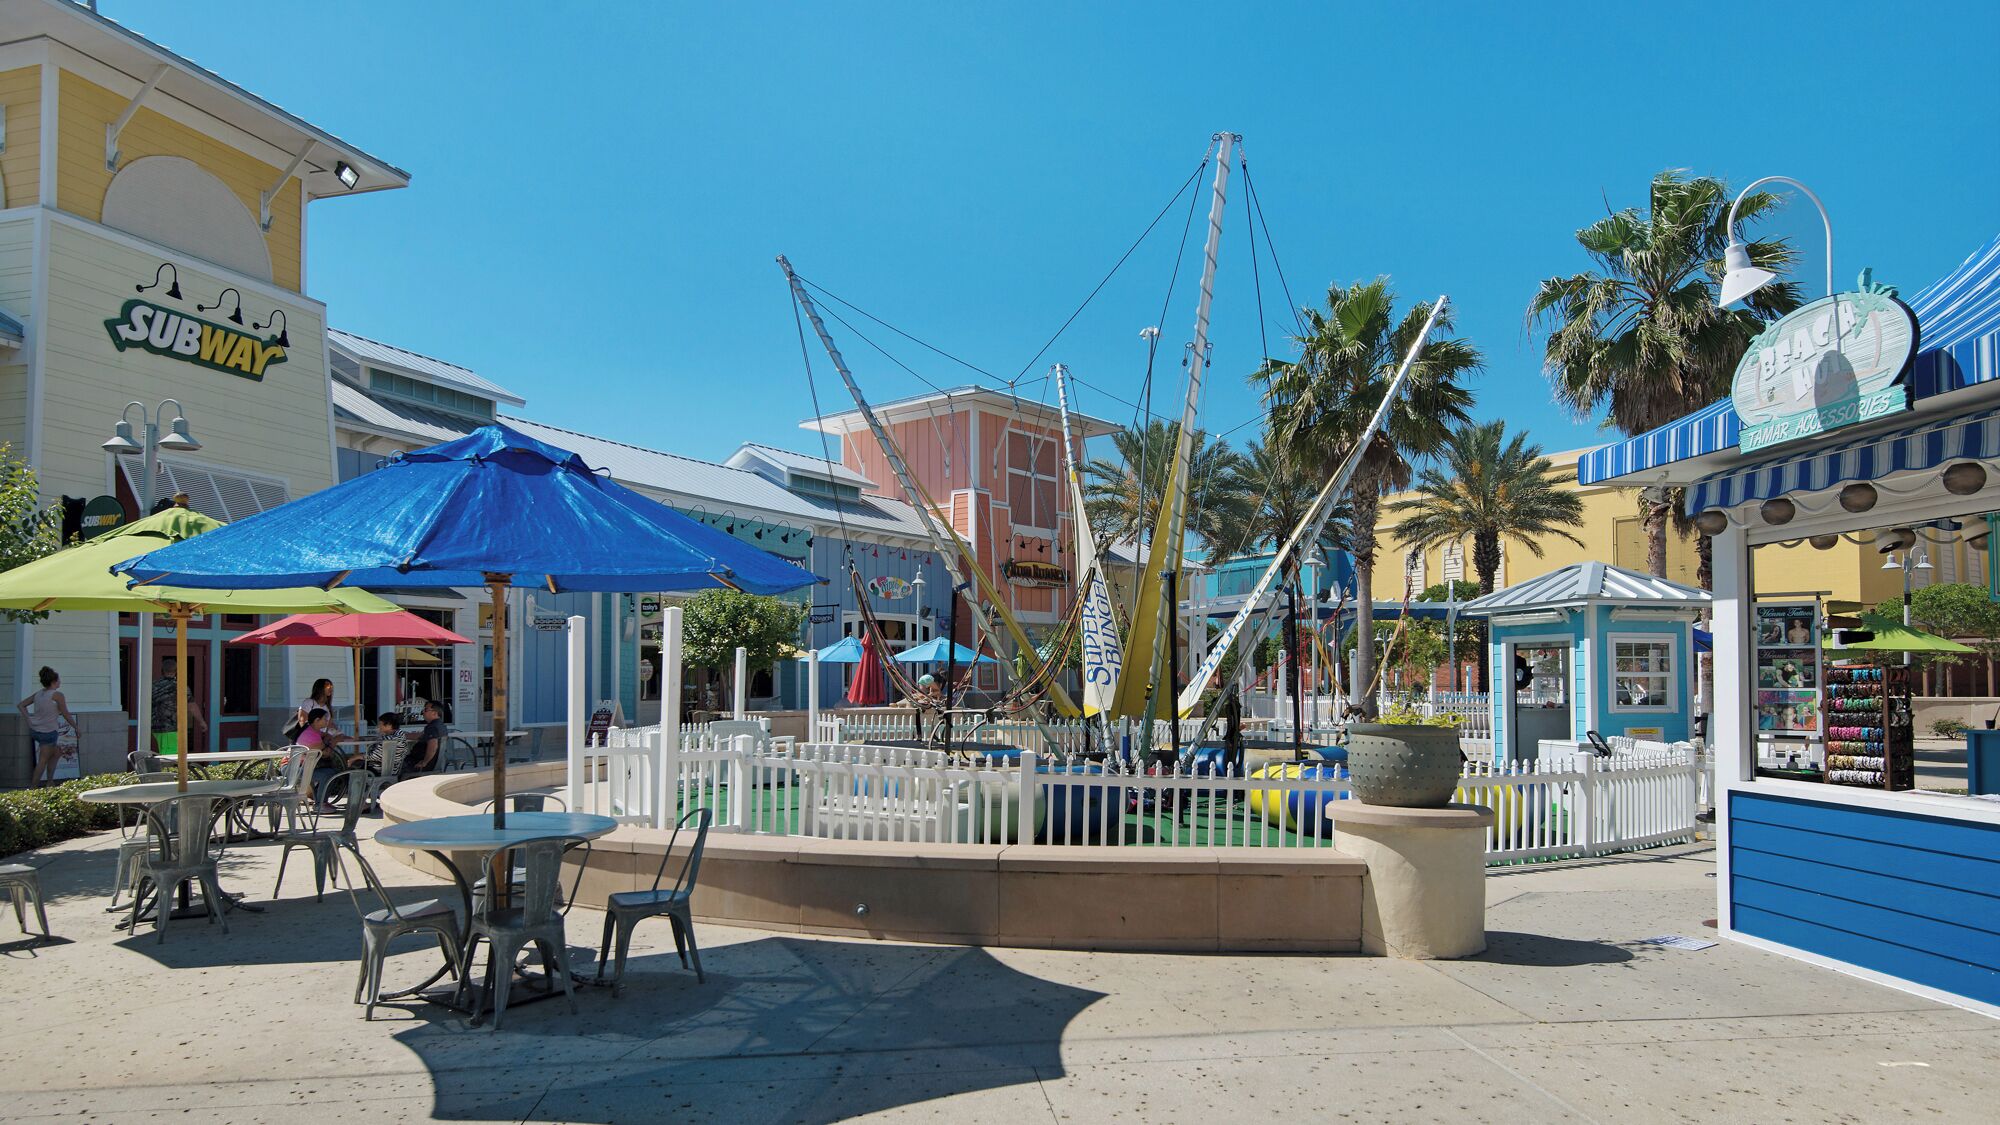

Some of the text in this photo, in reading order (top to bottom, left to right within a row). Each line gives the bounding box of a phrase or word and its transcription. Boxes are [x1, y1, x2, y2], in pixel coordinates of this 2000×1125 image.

[115, 305, 286, 376] SUBWAY
[1758, 302, 1857, 382] BEACH
[1791, 339, 1847, 401] HUT
[1748, 393, 1893, 449] TAMAR ACCESSORIES
[81, 513, 122, 528] SUBWAY
[1759, 606, 1815, 618] Henna Tattoos
[1081, 603, 1111, 687] SUPER
[1350, 651, 1355, 659] 2
